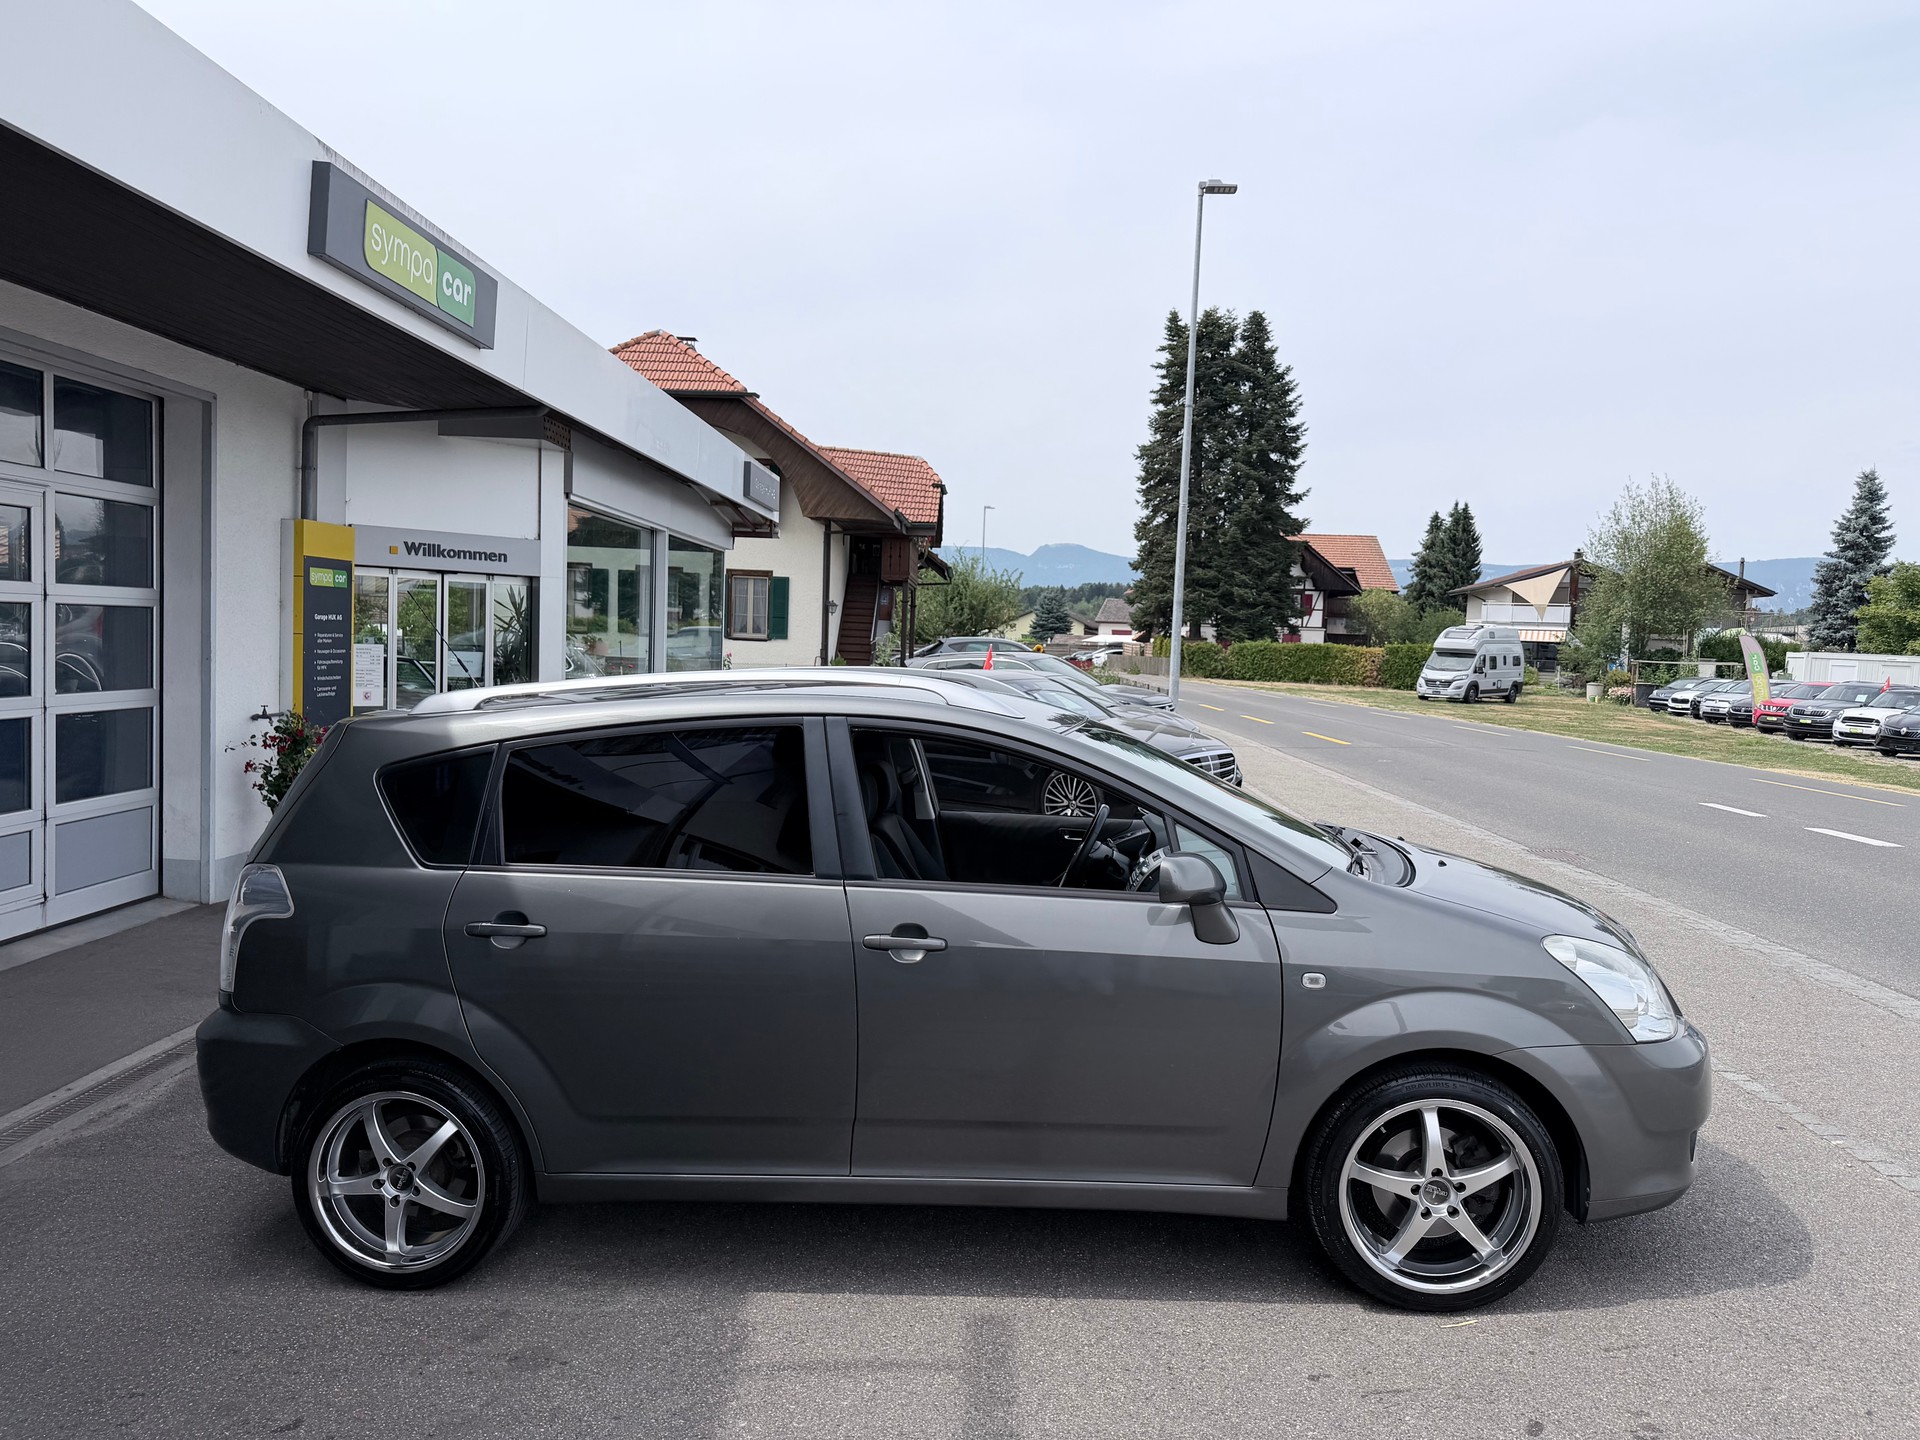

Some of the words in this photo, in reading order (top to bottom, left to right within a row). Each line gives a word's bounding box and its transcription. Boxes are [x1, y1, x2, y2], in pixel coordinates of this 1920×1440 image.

[371, 223, 433, 286] sympa
[442, 271, 472, 306] car
[403, 540, 508, 563] Willkommen
[311, 572, 333, 584] sympa
[334, 574, 346, 583] car
